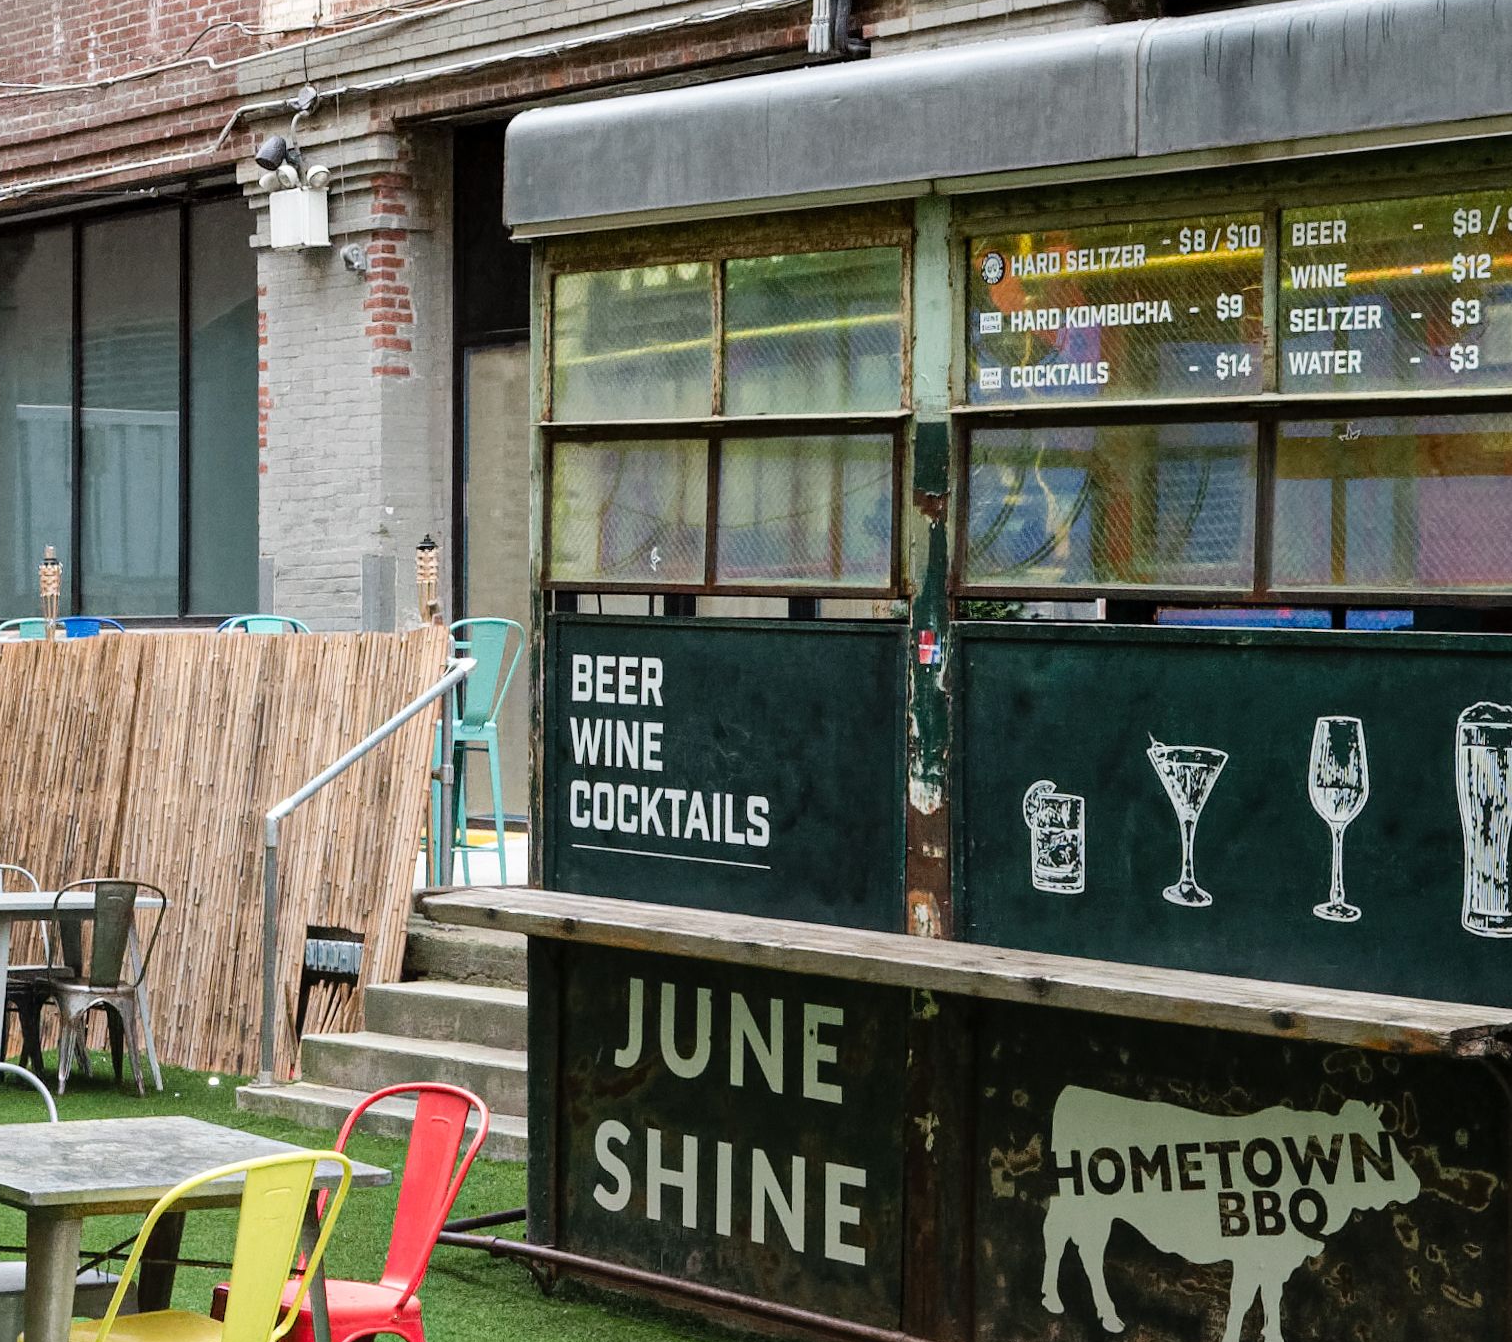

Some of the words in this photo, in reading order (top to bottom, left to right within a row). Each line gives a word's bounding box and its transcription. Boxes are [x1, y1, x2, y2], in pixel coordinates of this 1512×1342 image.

[1011, 251, 1060, 276] HARD
[1066, 244, 1145, 272] SELTZER
[1179, 227, 1206, 255] $8
[1227, 223, 1261, 251] $10
[1292, 220, 1347, 247] BEER
[1453, 208, 1482, 238] $8
[1290, 263, 1347, 289] WINE
[1451, 253, 1492, 283] $12
[1010, 306, 1060, 332] HARD
[1066, 300, 1173, 329] KOMBUCHA
[1216, 293, 1243, 321] $9
[1289, 304, 1382, 333] SELTZER
[1451, 297, 1480, 328] $3
[1010, 362, 1109, 388] COCKTAILS
[1216, 352, 1252, 381] $14
[1288, 349, 1362, 375] WATER
[1450, 342, 1479, 373] $3
[571, 654, 664, 706] BEER
[569, 716, 664, 772] WINE
[569, 779, 770, 847] COCKTAILS
[614, 977, 844, 1104] JUNE
[1050, 1131, 1396, 1197] HOMETOWN
[593, 1119, 866, 1266] SHINE
[1217, 1187, 1329, 1239] BBQ
